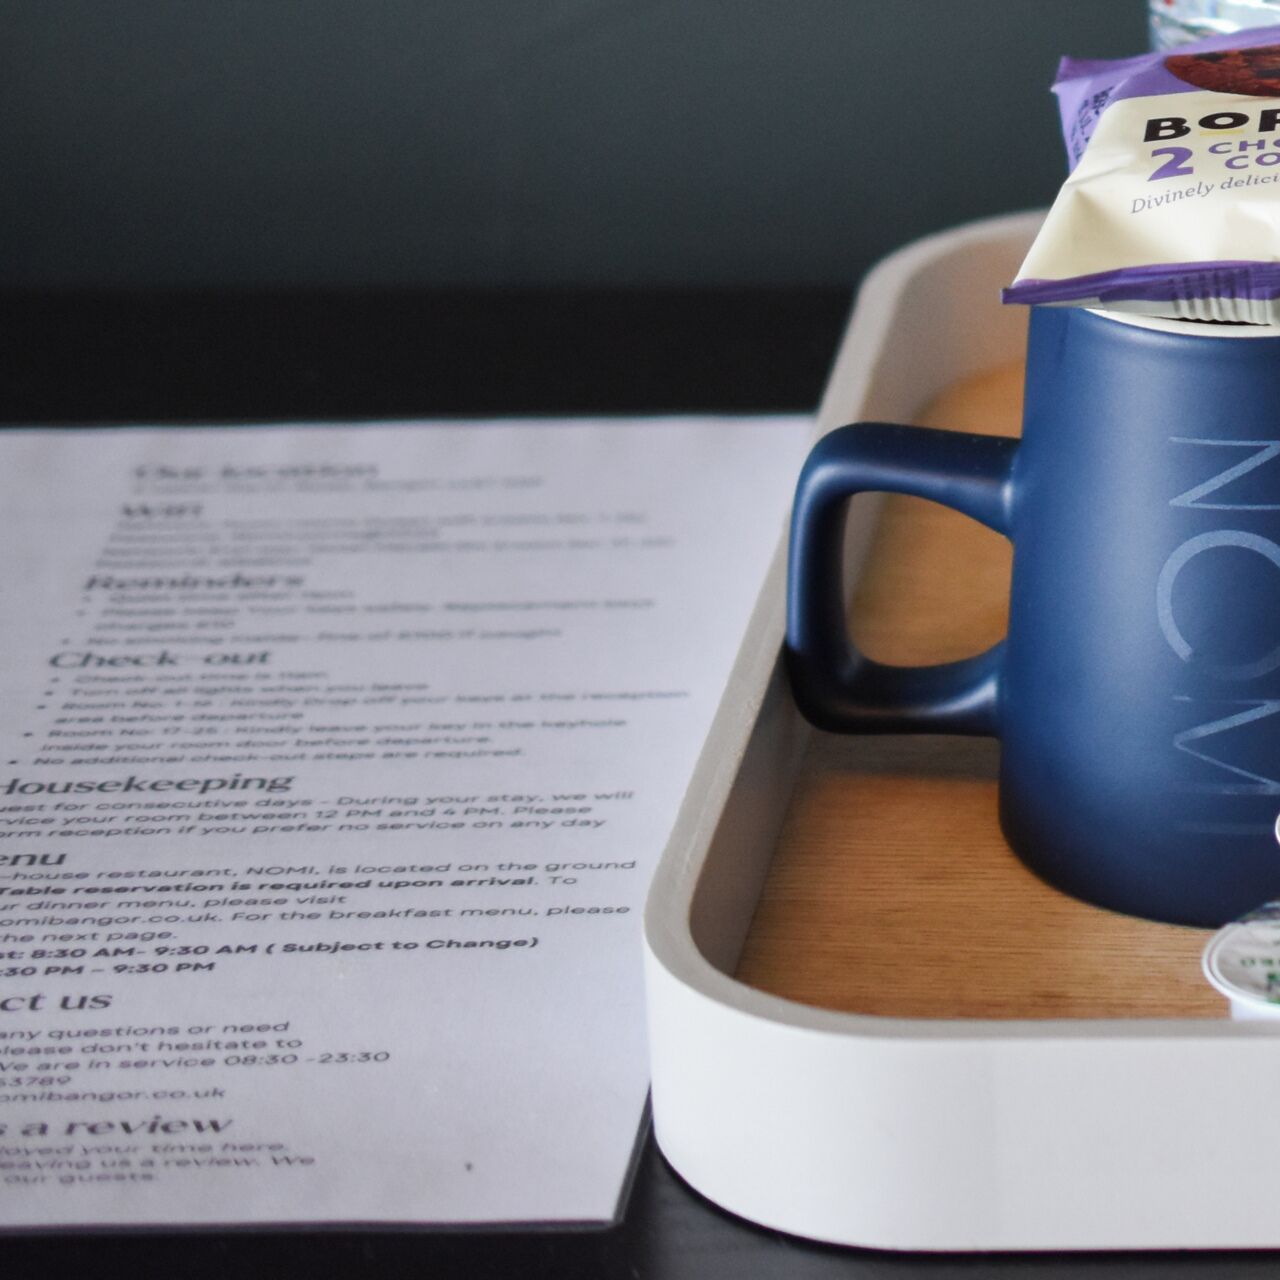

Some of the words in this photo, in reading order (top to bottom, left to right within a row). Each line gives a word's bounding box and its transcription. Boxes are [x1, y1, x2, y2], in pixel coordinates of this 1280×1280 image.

[1147, 146, 1194, 181] 2
[1131, 181, 1214, 214] Divinely
[71, 756, 184, 765] additional
[55, 802, 88, 811] for
[96, 800, 247, 810] consecutive
[256, 798, 313, 808] days
[337, 796, 417, 806] During
[426, 796, 480, 805] your
[595, 791, 634, 800] will
[63, 816, 121, 826] your
[198, 813, 306, 821] between
[315, 810, 339, 819] 12
[390, 808, 435, 817] and
[514, 806, 592, 814] Please
[48, 827, 170, 837] reception
[178, 825, 195, 834] if
[202, 827, 246, 835] you
[252, 824, 333, 834] prefer
[376, 821, 465, 830] service
[510, 821, 554, 829] any
[560, 819, 606, 828] day
[328, 865, 346, 874] is
[355, 864, 451, 873] located
[497, 863, 537, 871] the
[545, 861, 637, 872] ground
[73, 883, 223, 894] reservation
[230, 882, 251, 890] is
[258, 880, 370, 891] required
[378, 881, 442, 889] upon
[549, 876, 577, 884] To
[26, 901, 109, 910] dinner
[203, 898, 287, 908] please
[296, 896, 347, 904] visit
[232, 912, 272, 921] For
[280, 911, 320, 920] the
[329, 909, 452, 919] breakfast
[547, 906, 631, 916] please
[42, 933, 98, 942] next
[31, 949, 85, 959] 8:30
[155, 946, 210, 956] 9:30
[216, 945, 257, 954] AM
[282, 942, 386, 953] Subject
[392, 942, 419, 950] to
[426, 937, 540, 949] Change)
[44, 966, 84, 975] PM
[113, 964, 169, 973] 9:30
[176, 962, 216, 972] PM
[60, 995, 113, 1010] us
[48, 1026, 180, 1040] questions
[187, 1026, 214, 1035] or
[222, 1022, 290, 1033] need
[81, 1043, 149, 1053] don't
[157, 1040, 267, 1051] hesitate
[276, 1040, 302, 1048] to
[36, 1062, 80, 1071] are
[88, 1060, 110, 1069] in
[119, 1057, 216, 1069] service
[224, 1054, 298, 1066] 08:30
[21, 1123, 48, 1136] a
[64, 1116, 233, 1135] review
[81, 1146, 140, 1156] your
[152, 1144, 212, 1154] time
[101, 1158, 132, 1168] us
[271, 1156, 316, 1166] We
[4, 1174, 48, 1185] our
